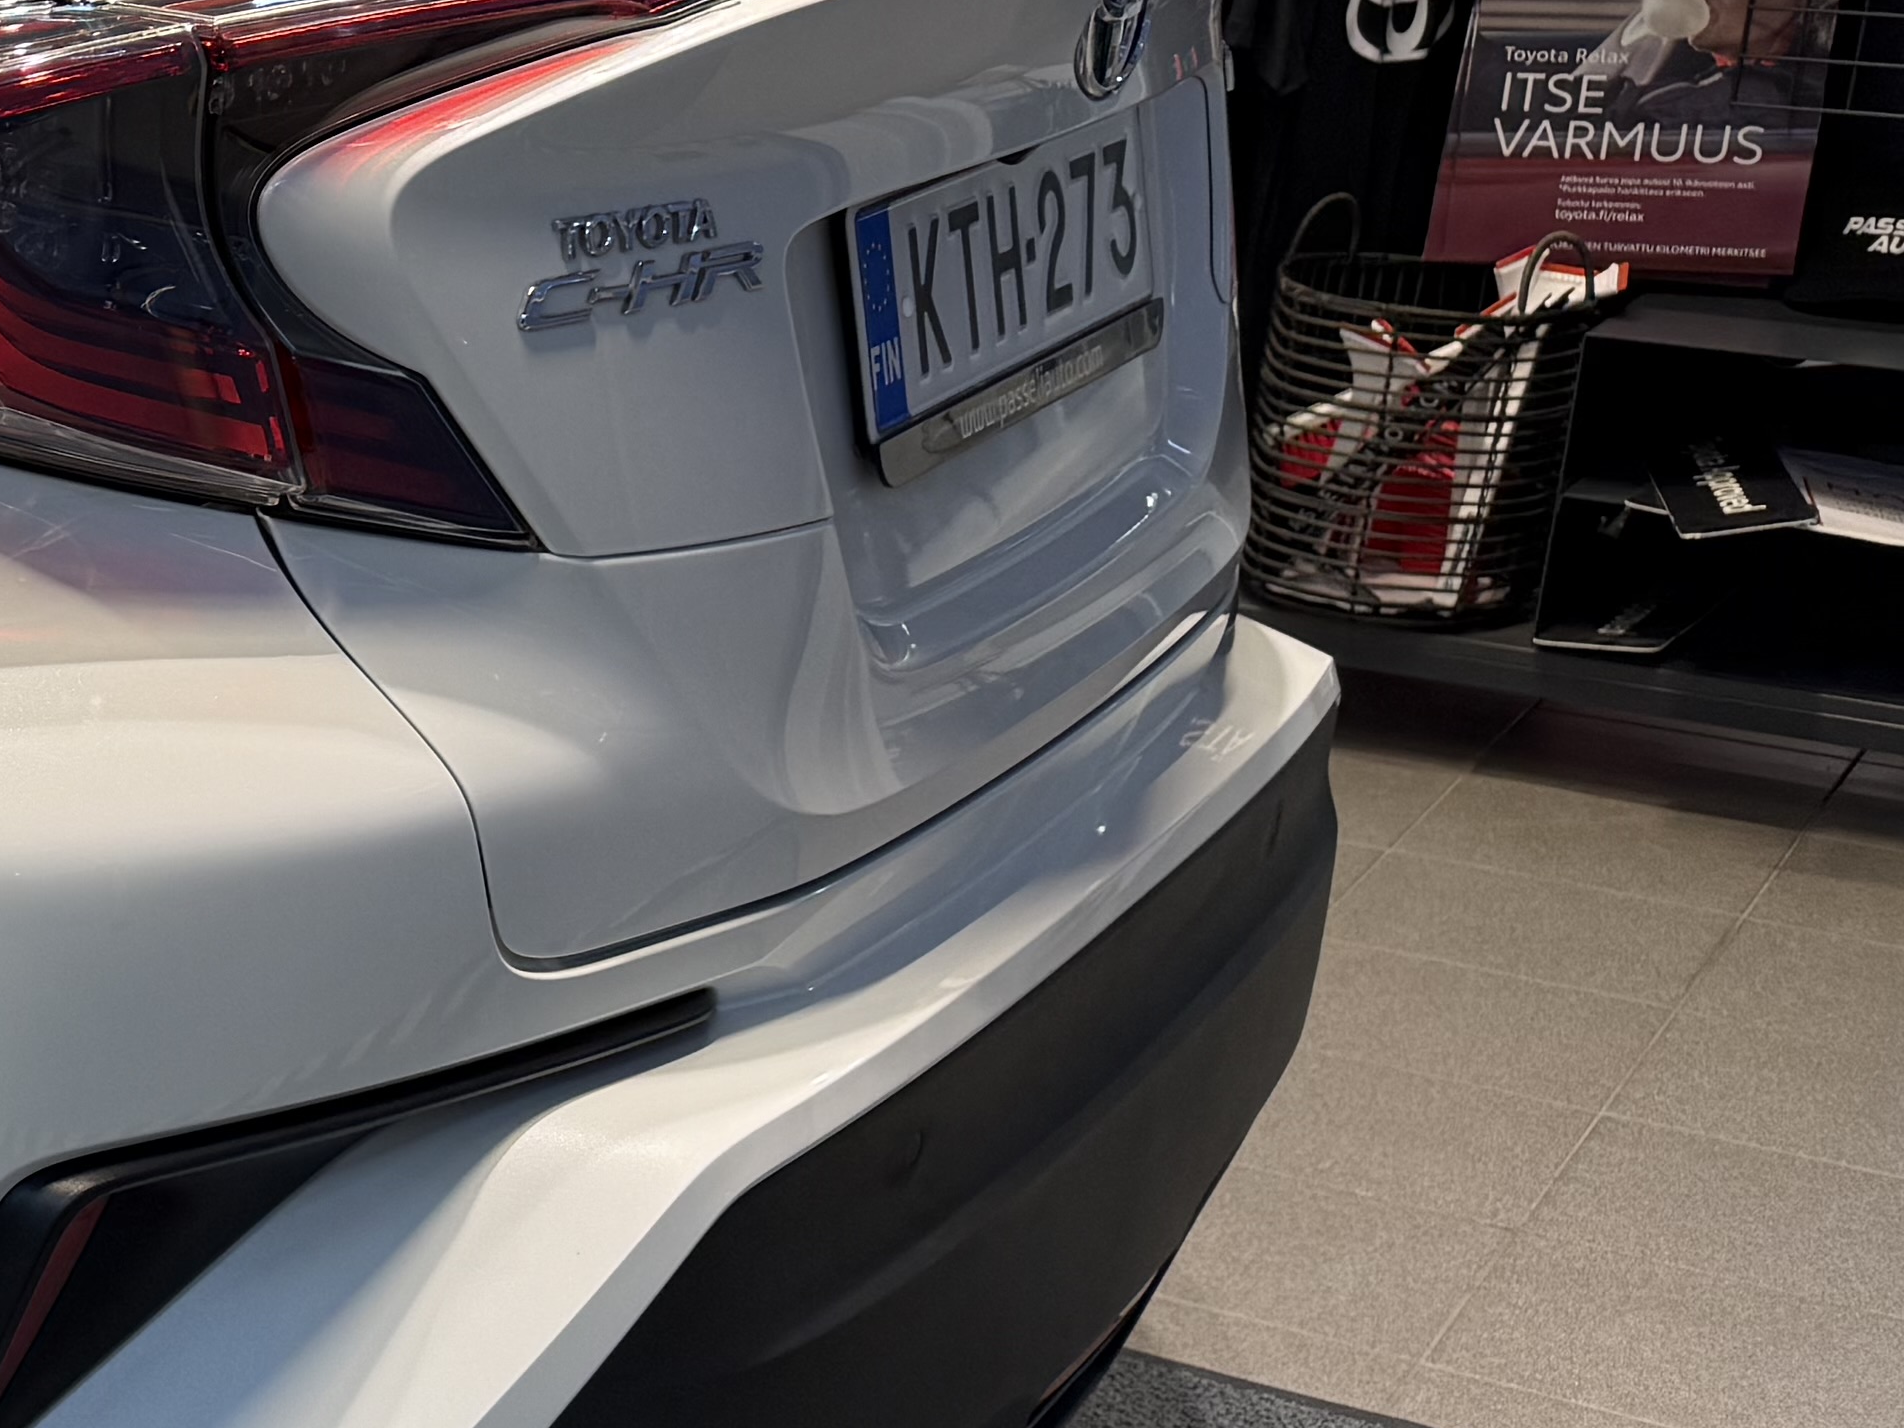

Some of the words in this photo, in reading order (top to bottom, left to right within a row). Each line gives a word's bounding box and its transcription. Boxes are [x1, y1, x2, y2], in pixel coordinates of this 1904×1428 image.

[1505, 45, 1568, 66] Toyota
[1576, 47, 1630, 65] Relax
[1501, 71, 1608, 114] ITSE
[1494, 117, 1765, 165] VARMUUS
[551, 198, 718, 262] TOYOTA
[1554, 208, 1645, 223] toyota.fi/relax
[906, 138, 1139, 377] KTH-273
[516, 241, 765, 333] C-HR
[869, 335, 904, 393] FIN
